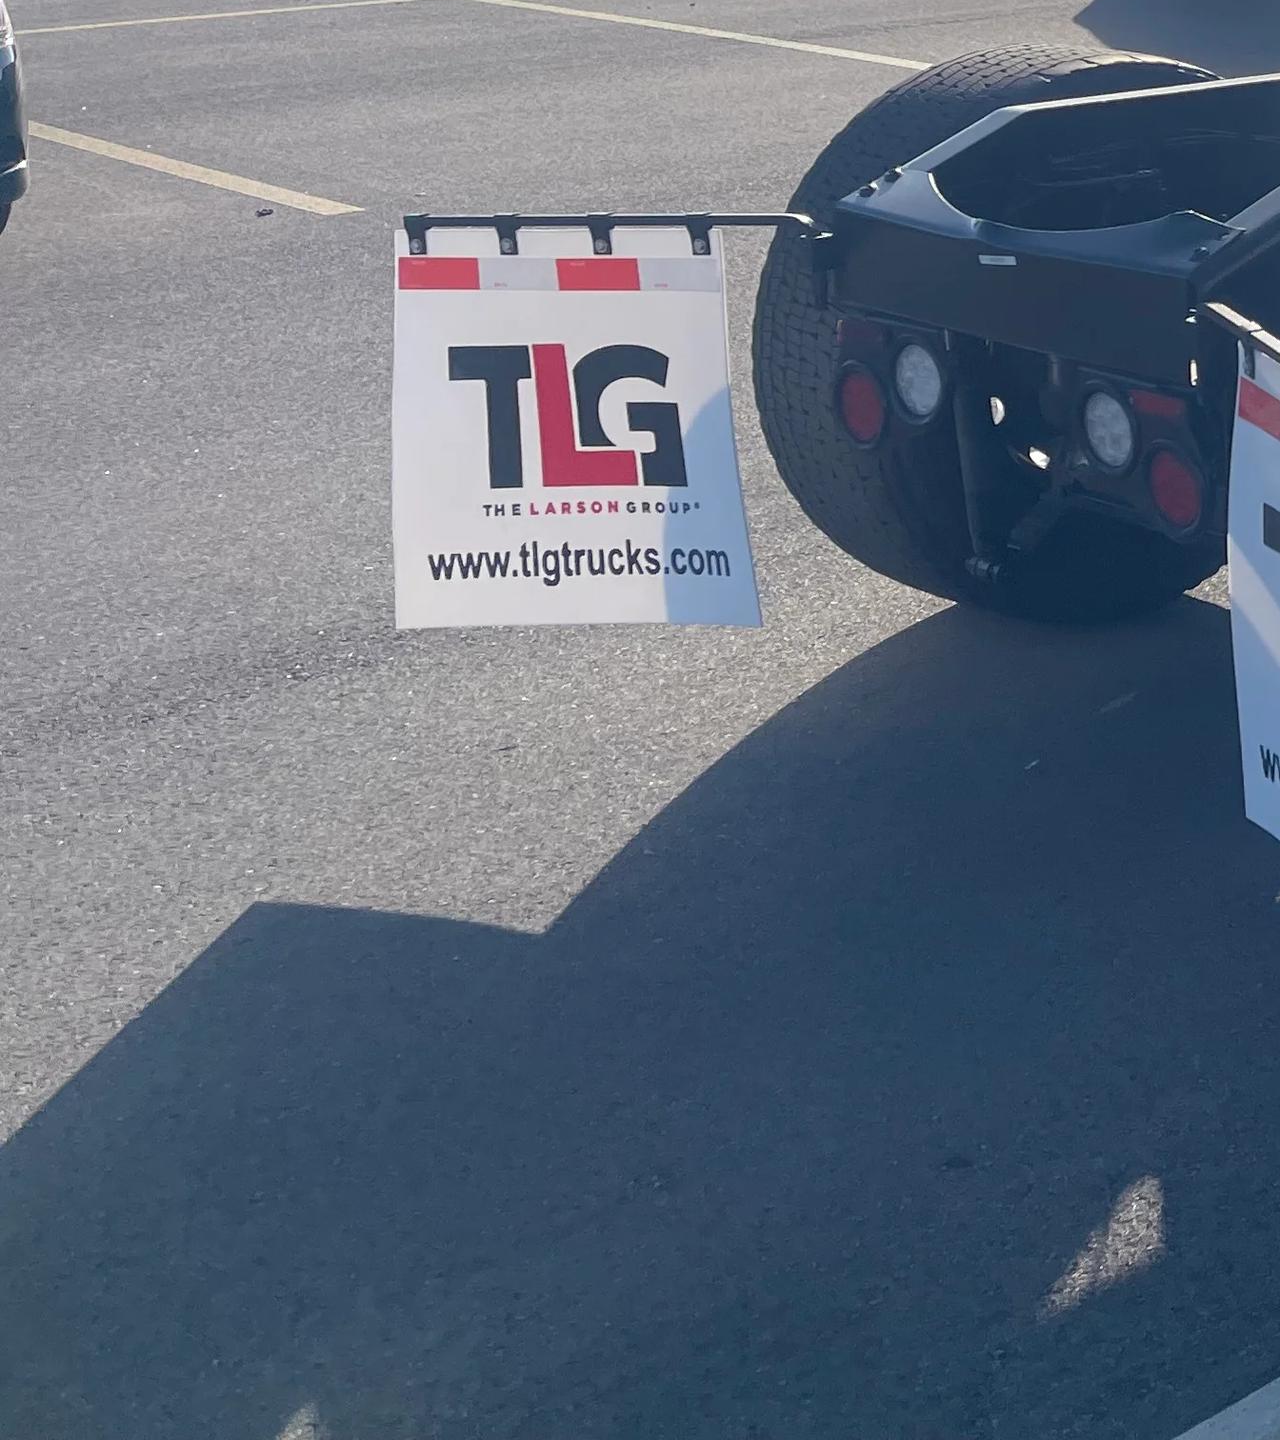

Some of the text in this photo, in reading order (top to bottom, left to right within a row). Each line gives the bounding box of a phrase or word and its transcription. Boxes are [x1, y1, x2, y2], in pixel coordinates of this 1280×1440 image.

[447, 343, 688, 489] TLG
[482, 503, 522, 517] THE
[529, 501, 620, 515] LARSON
[428, 538, 731, 587] www.tlgtrucks.com
